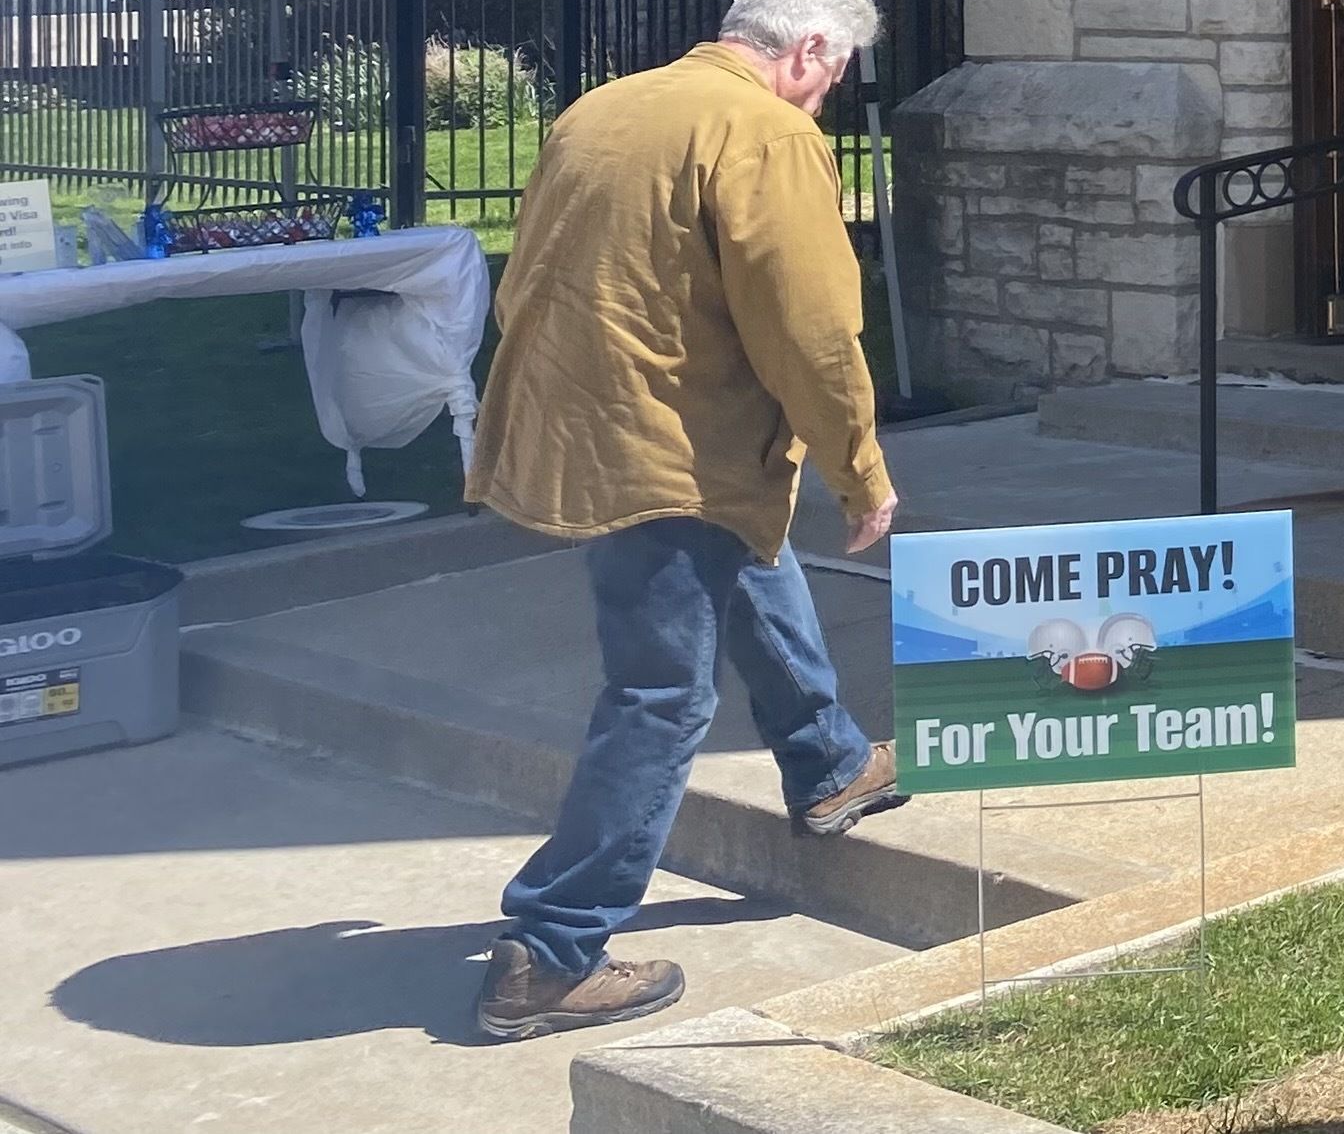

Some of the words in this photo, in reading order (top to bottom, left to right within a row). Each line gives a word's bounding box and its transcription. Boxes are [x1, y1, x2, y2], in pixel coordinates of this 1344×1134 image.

[9, 210, 38, 220] Visa
[950, 553, 1082, 608] COME
[1097, 540, 1235, 599] PRAY!
[915, 718, 995, 768] For
[1007, 712, 1119, 761] Your
[1130, 692, 1275, 753] Team!
